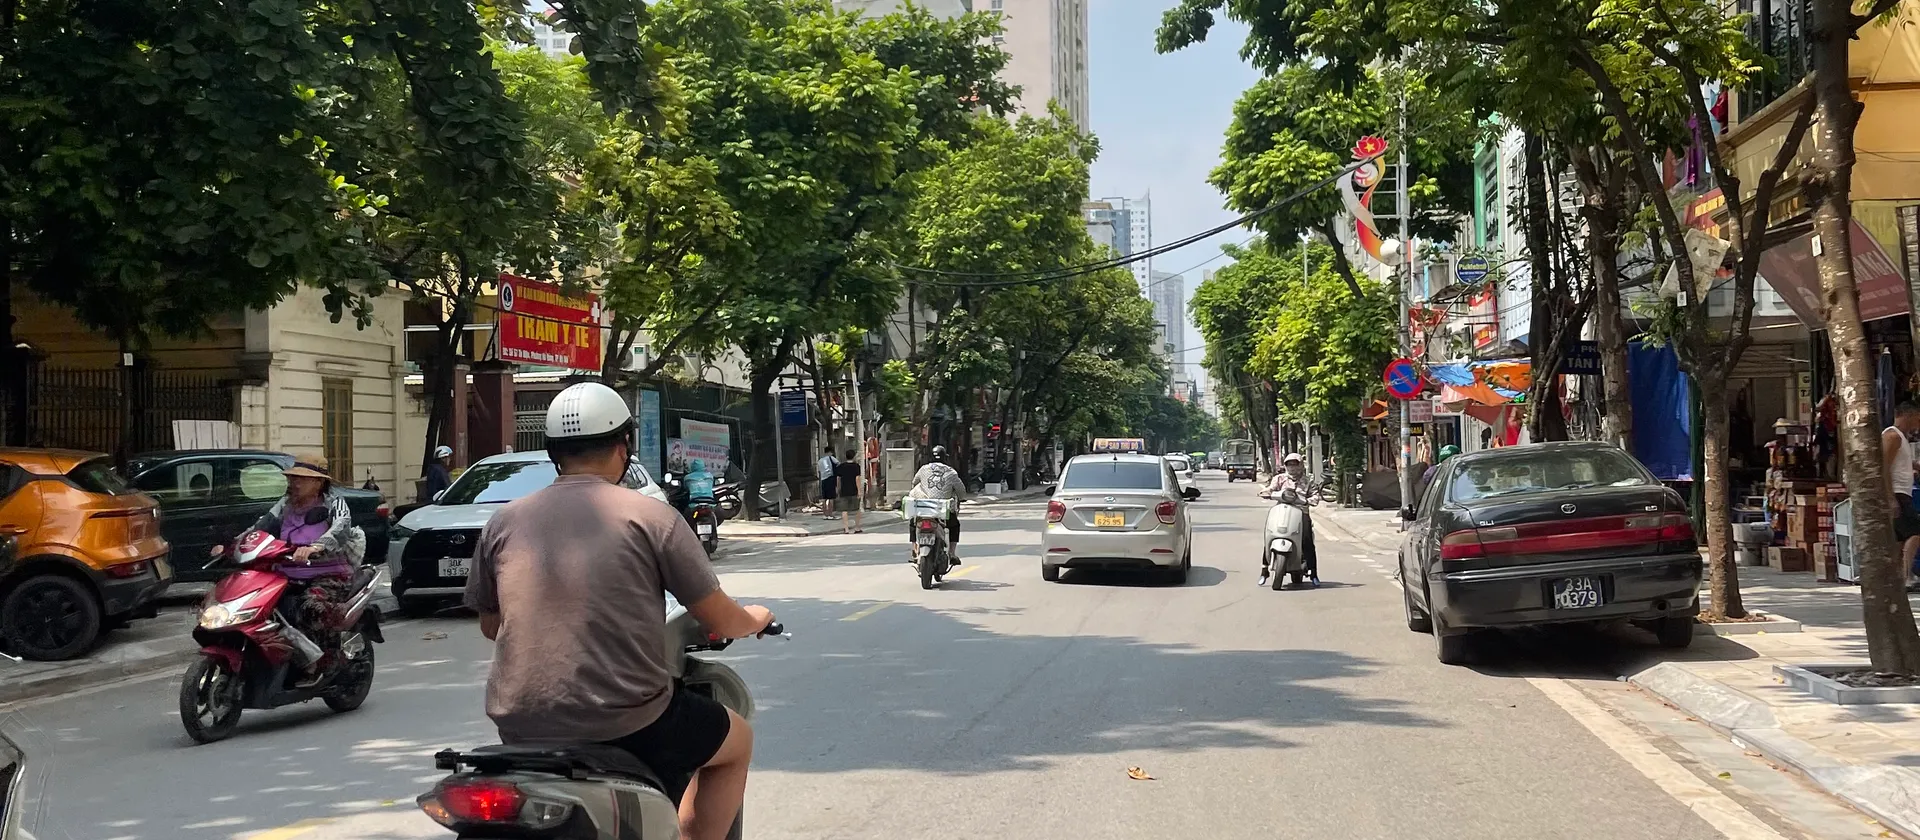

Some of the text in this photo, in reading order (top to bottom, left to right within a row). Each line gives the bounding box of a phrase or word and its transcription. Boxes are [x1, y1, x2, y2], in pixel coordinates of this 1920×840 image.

[516, 311, 559, 345] TRẠM
[561, 319, 570, 345] Y
[1564, 577, 1593, 592] 33A
